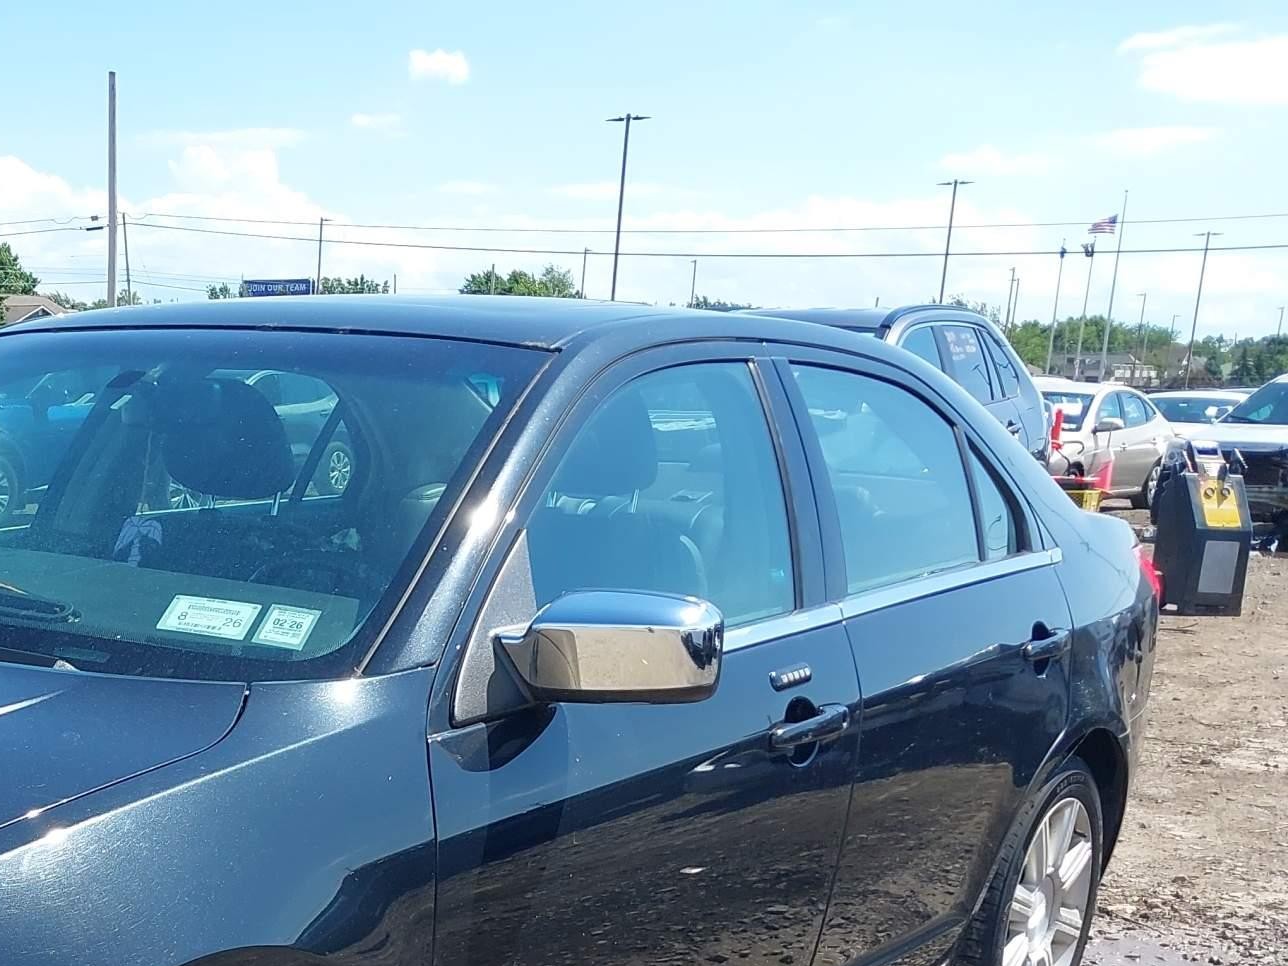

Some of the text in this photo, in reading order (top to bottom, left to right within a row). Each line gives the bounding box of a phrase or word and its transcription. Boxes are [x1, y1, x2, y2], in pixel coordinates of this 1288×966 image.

[248, 282, 307, 293] JOIN OUR TEAM
[177, 611, 189, 621] 8
[222, 617, 243, 628] 26
